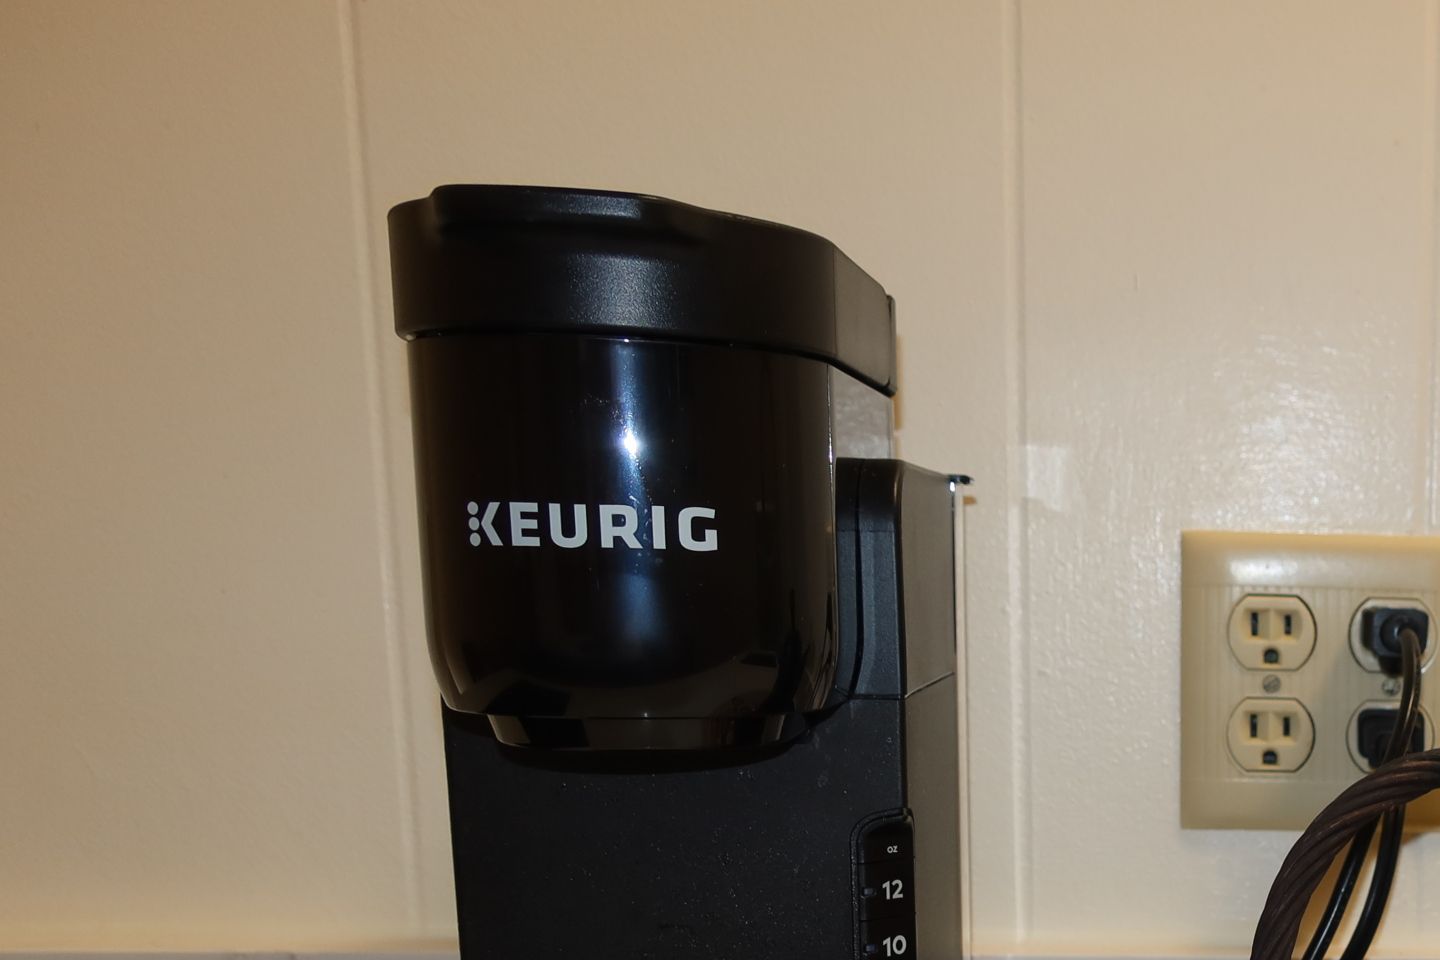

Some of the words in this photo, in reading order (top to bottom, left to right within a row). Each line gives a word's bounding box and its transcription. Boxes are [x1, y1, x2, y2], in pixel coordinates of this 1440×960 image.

[467, 501, 718, 551] KEURIG
[882, 879, 904, 900] 12
[882, 935, 907, 957] 10
